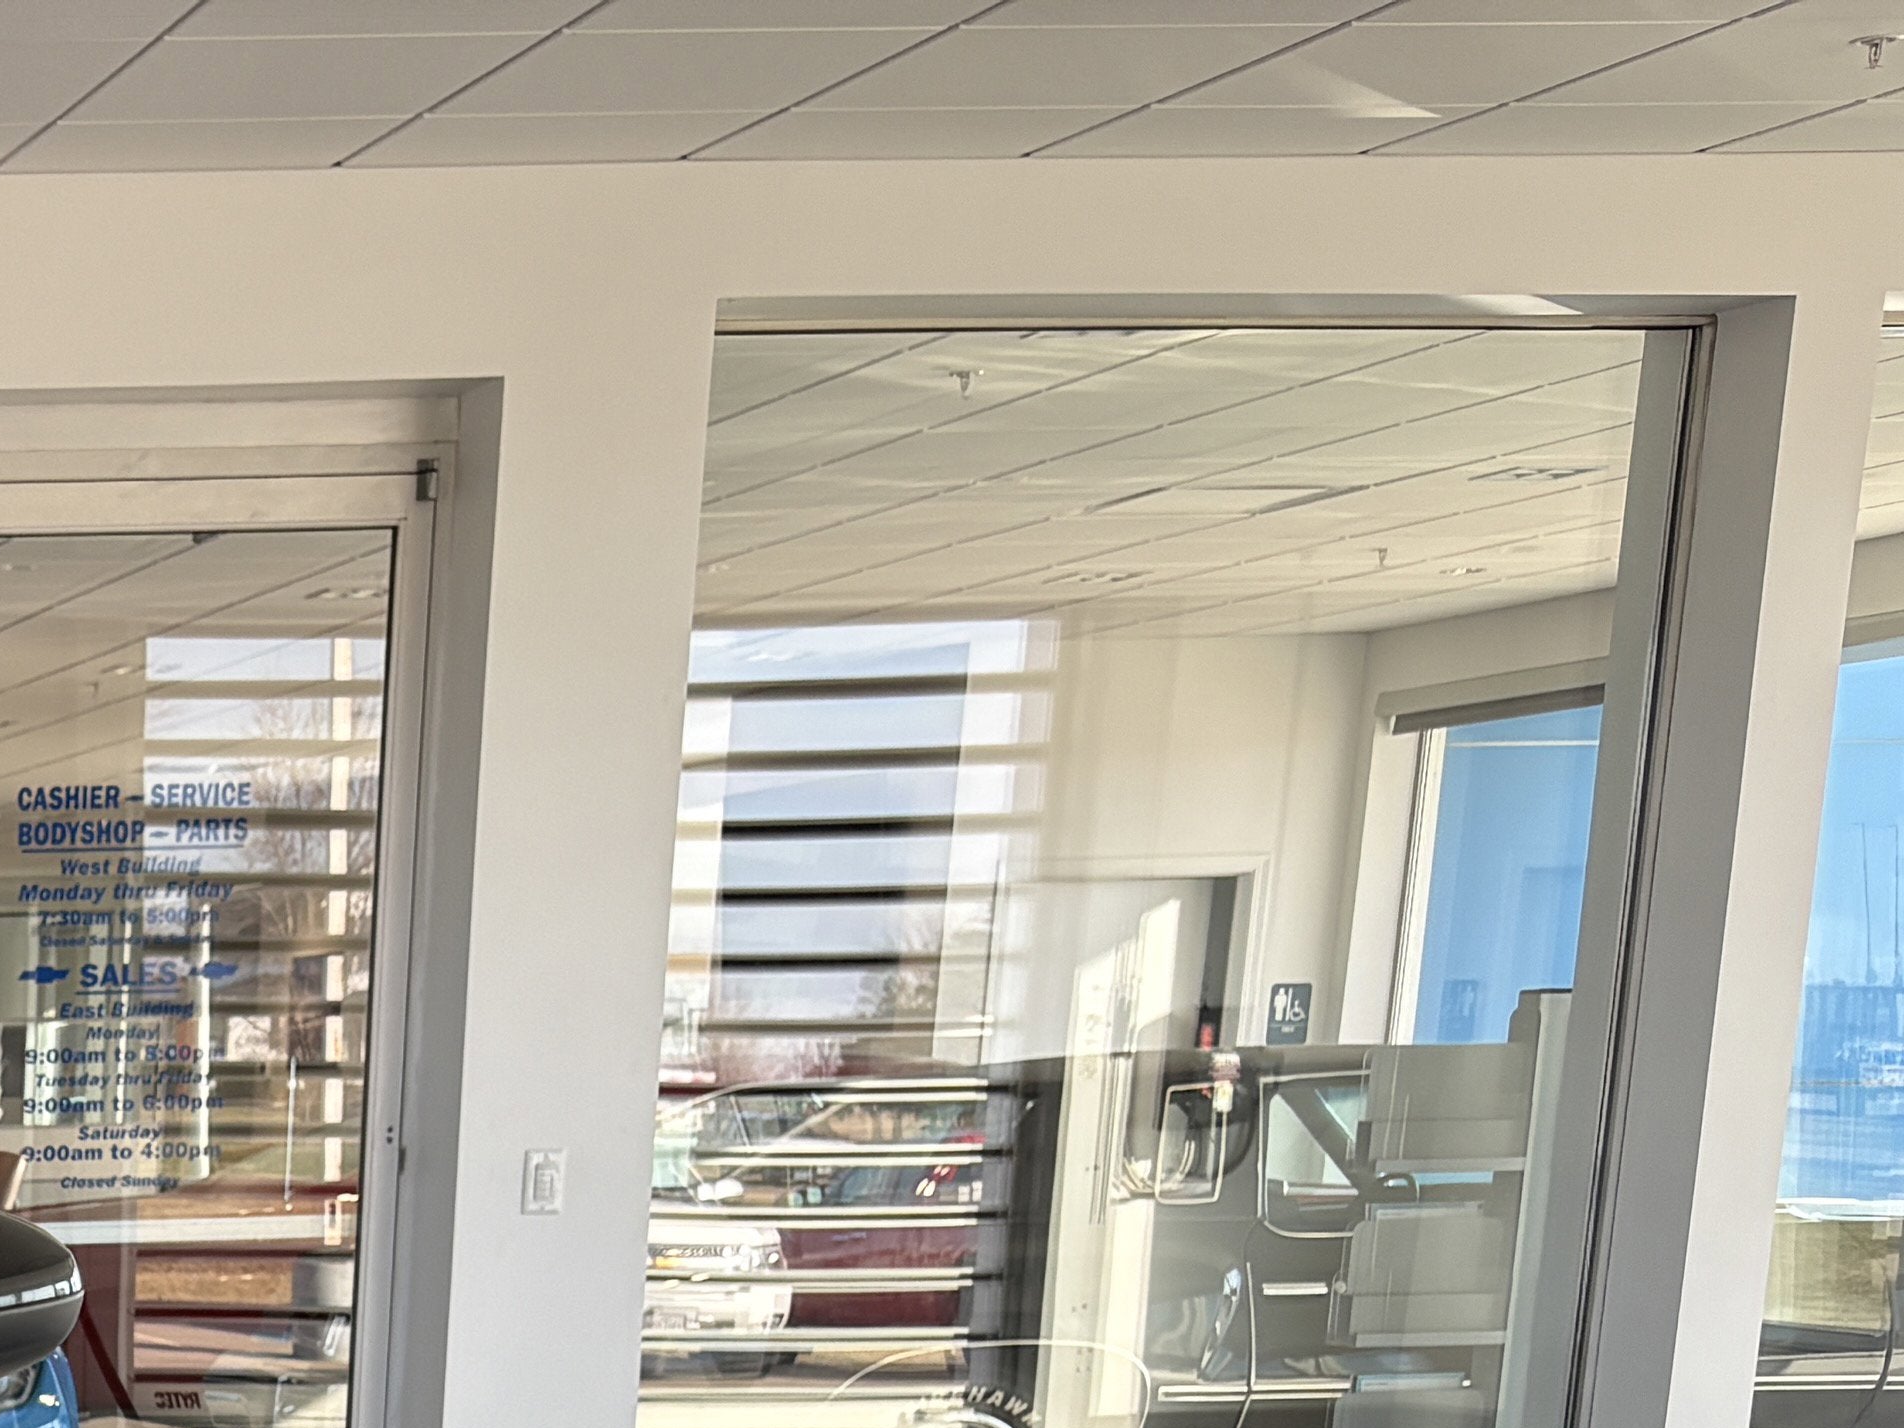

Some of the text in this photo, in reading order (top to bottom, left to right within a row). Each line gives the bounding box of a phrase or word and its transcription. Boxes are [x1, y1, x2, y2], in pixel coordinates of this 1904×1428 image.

[17, 782, 251, 811] CASHIER SERVICE
[18, 818, 248, 846] BODYSHOP PARTS
[61, 856, 202, 876] West Building
[18, 881, 234, 904] Monday thru Friday
[40, 910, 113, 928] 7:30am
[119, 909, 139, 926] to
[79, 961, 178, 987] SALES
[60, 1001, 194, 1019] East Building
[85, 1025, 159, 1042] Monday
[25, 1047, 106, 1065] 9:00am
[115, 1046, 137, 1062] to
[35, 1073, 110, 1089] Tuesday
[116, 1072, 151, 1087] thru
[24, 1096, 104, 1114] 9:00am
[113, 1096, 134, 1112] to
[78, 1125, 163, 1142] Saturday
[21, 1143, 222, 1163] 9:00am to 4:00pm
[61, 1175, 179, 1194] Closed Sunday
